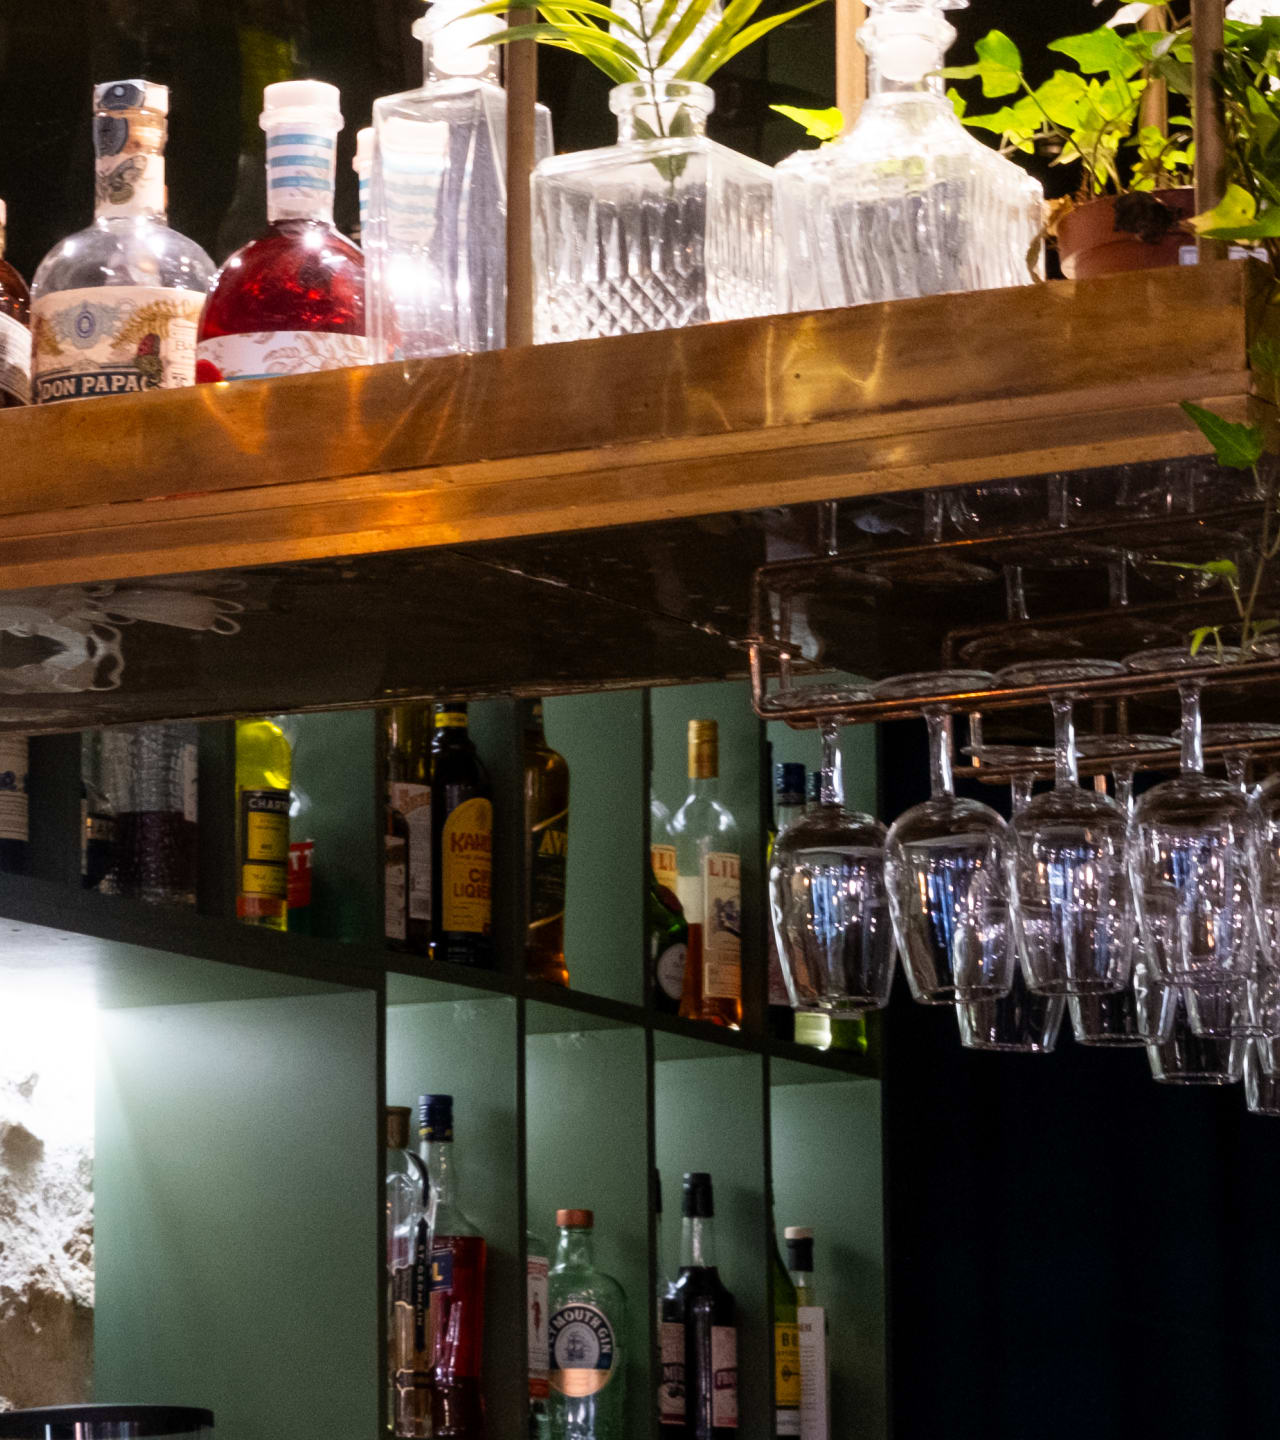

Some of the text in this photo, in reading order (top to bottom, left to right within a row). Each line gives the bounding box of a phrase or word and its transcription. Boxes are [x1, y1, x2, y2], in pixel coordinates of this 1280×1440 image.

[42, 375, 140, 400] DON PAPA
[549, 1308, 612, 1354] LYMOUTH GIN
